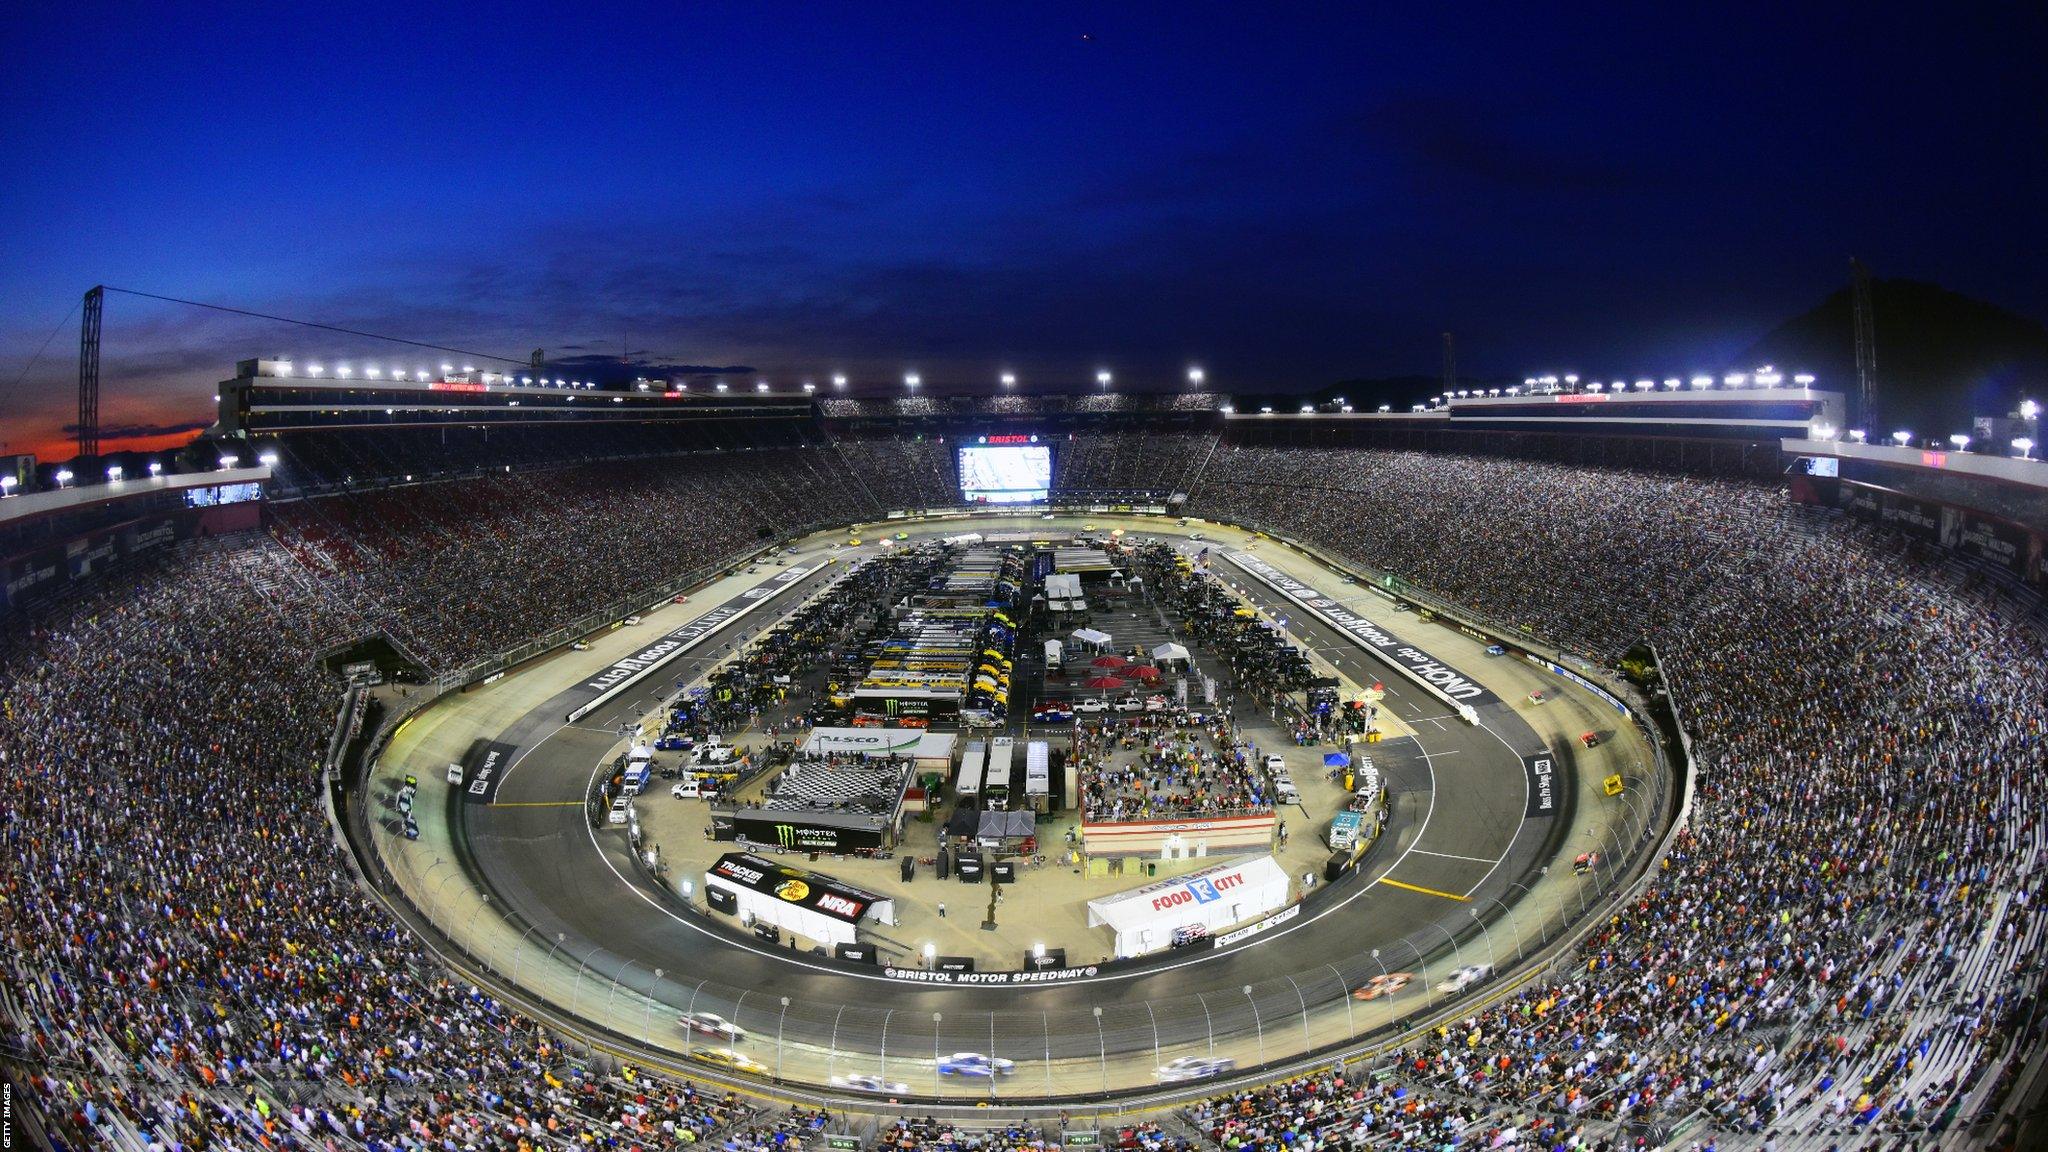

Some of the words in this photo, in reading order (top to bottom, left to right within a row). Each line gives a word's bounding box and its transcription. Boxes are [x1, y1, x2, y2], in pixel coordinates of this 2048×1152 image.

[988, 434, 1029, 443] BRISTOL
[638, 640, 680, 660] FOOD
[589, 668, 631, 691] CITY
[796, 829, 837, 837] MONSTER
[720, 860, 764, 881] TRACKER
[1152, 890, 1193, 911] FOOD
[1213, 873, 1244, 891] CITY
[817, 893, 858, 917] NRA
[896, 970, 952, 982] BRISTOL
[957, 973, 1008, 983] MOTOR
[1012, 968, 1086, 982] SPEEDWAY
